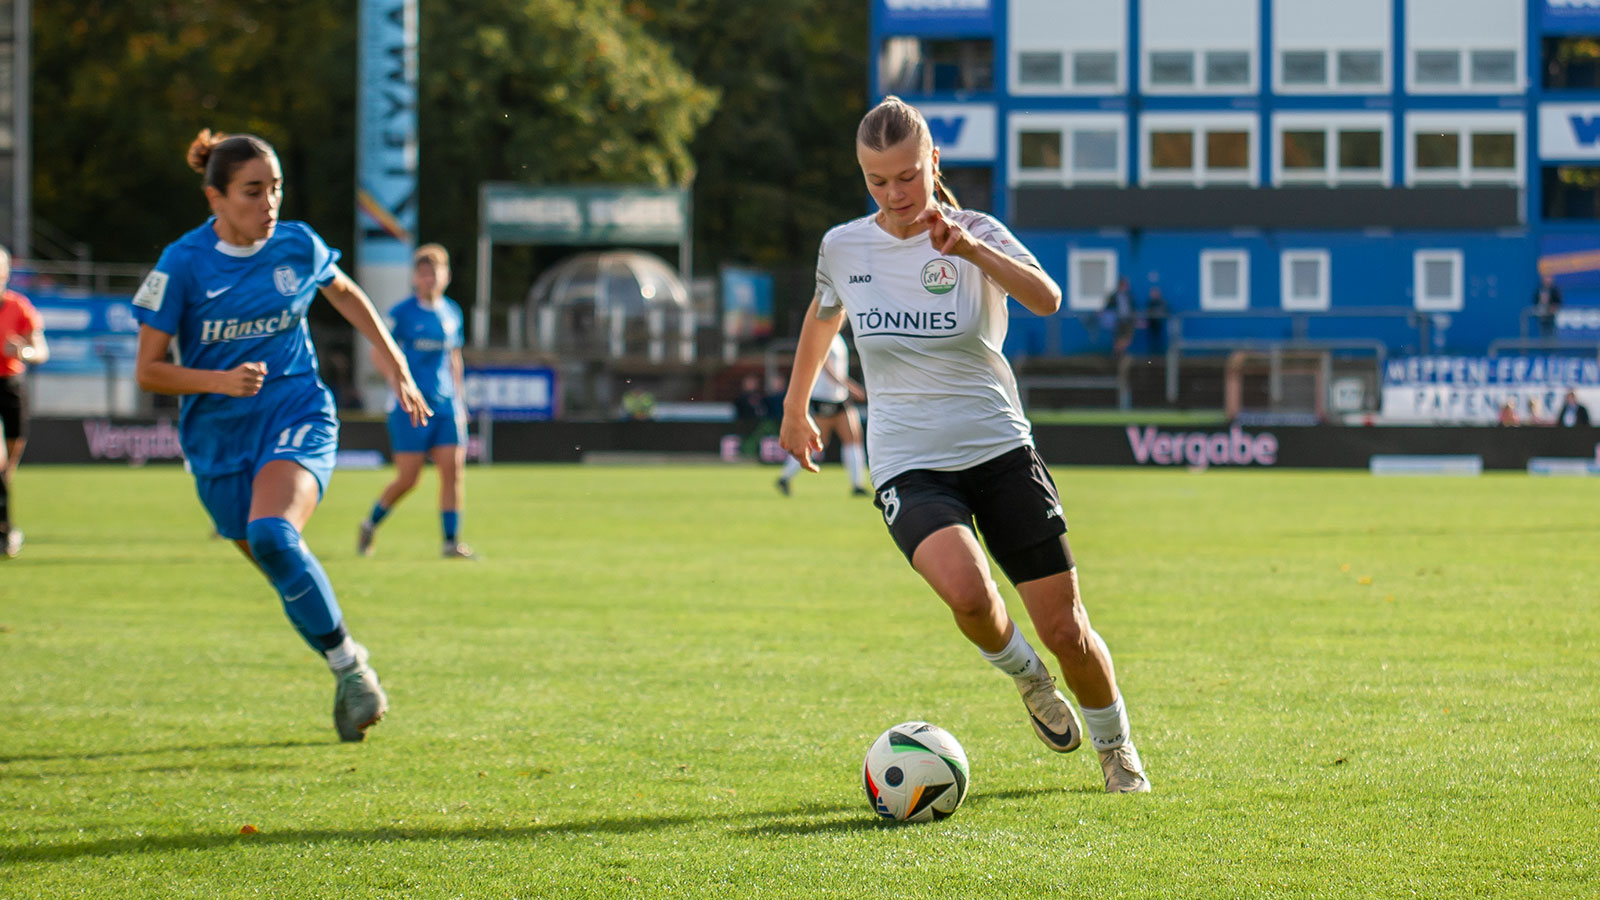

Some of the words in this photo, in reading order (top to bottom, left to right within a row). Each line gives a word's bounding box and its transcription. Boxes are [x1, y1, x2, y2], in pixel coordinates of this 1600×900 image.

[848, 274, 872, 285] JAKO
[856, 308, 958, 330] TÖNNIES
[83, 418, 182, 466] Vergab
[1126, 425, 1278, 473] Vergabe
[880, 487, 900, 526] 8
